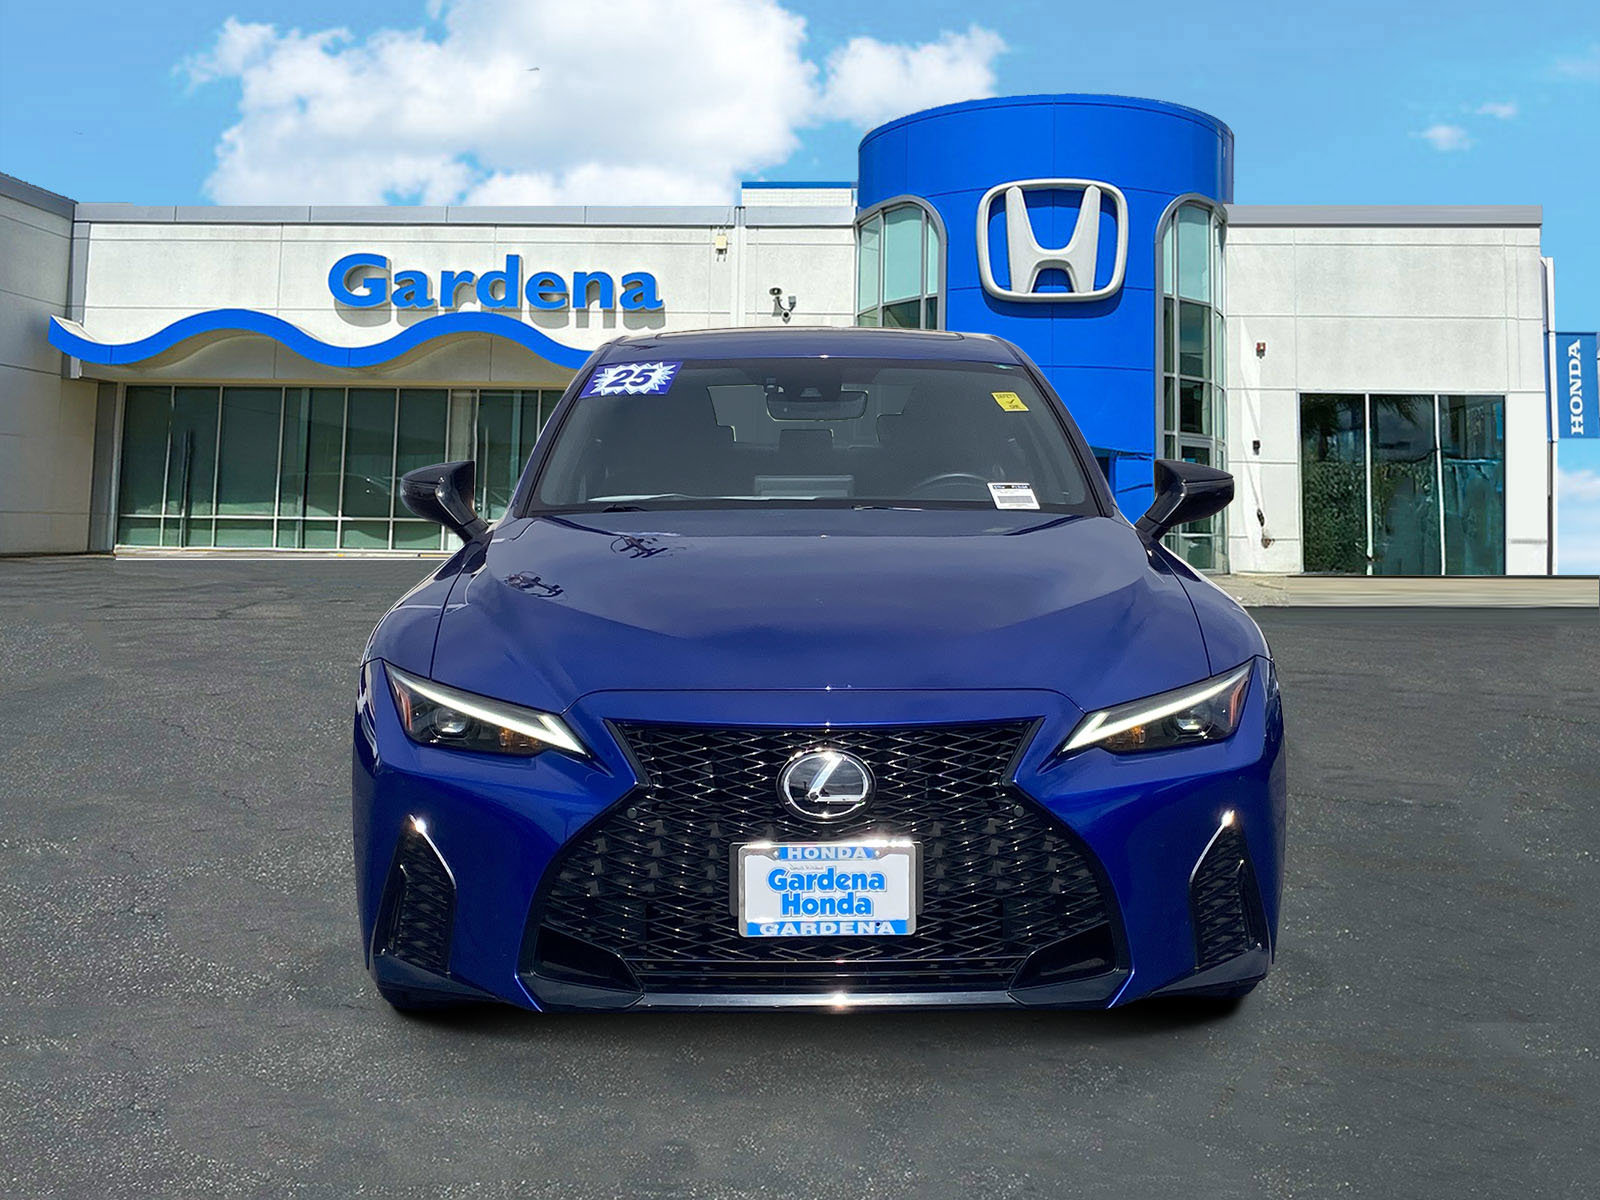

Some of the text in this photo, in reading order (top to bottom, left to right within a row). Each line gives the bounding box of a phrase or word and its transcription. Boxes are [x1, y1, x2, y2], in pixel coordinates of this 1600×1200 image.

[328, 253, 664, 310] Gardena
[604, 368, 658, 388] 25
[1568, 339, 1584, 434] HONDA
[787, 847, 869, 859] HONDA
[767, 867, 886, 891] Gardena
[781, 893, 872, 915] Honda
[760, 921, 895, 935] GARDENA
